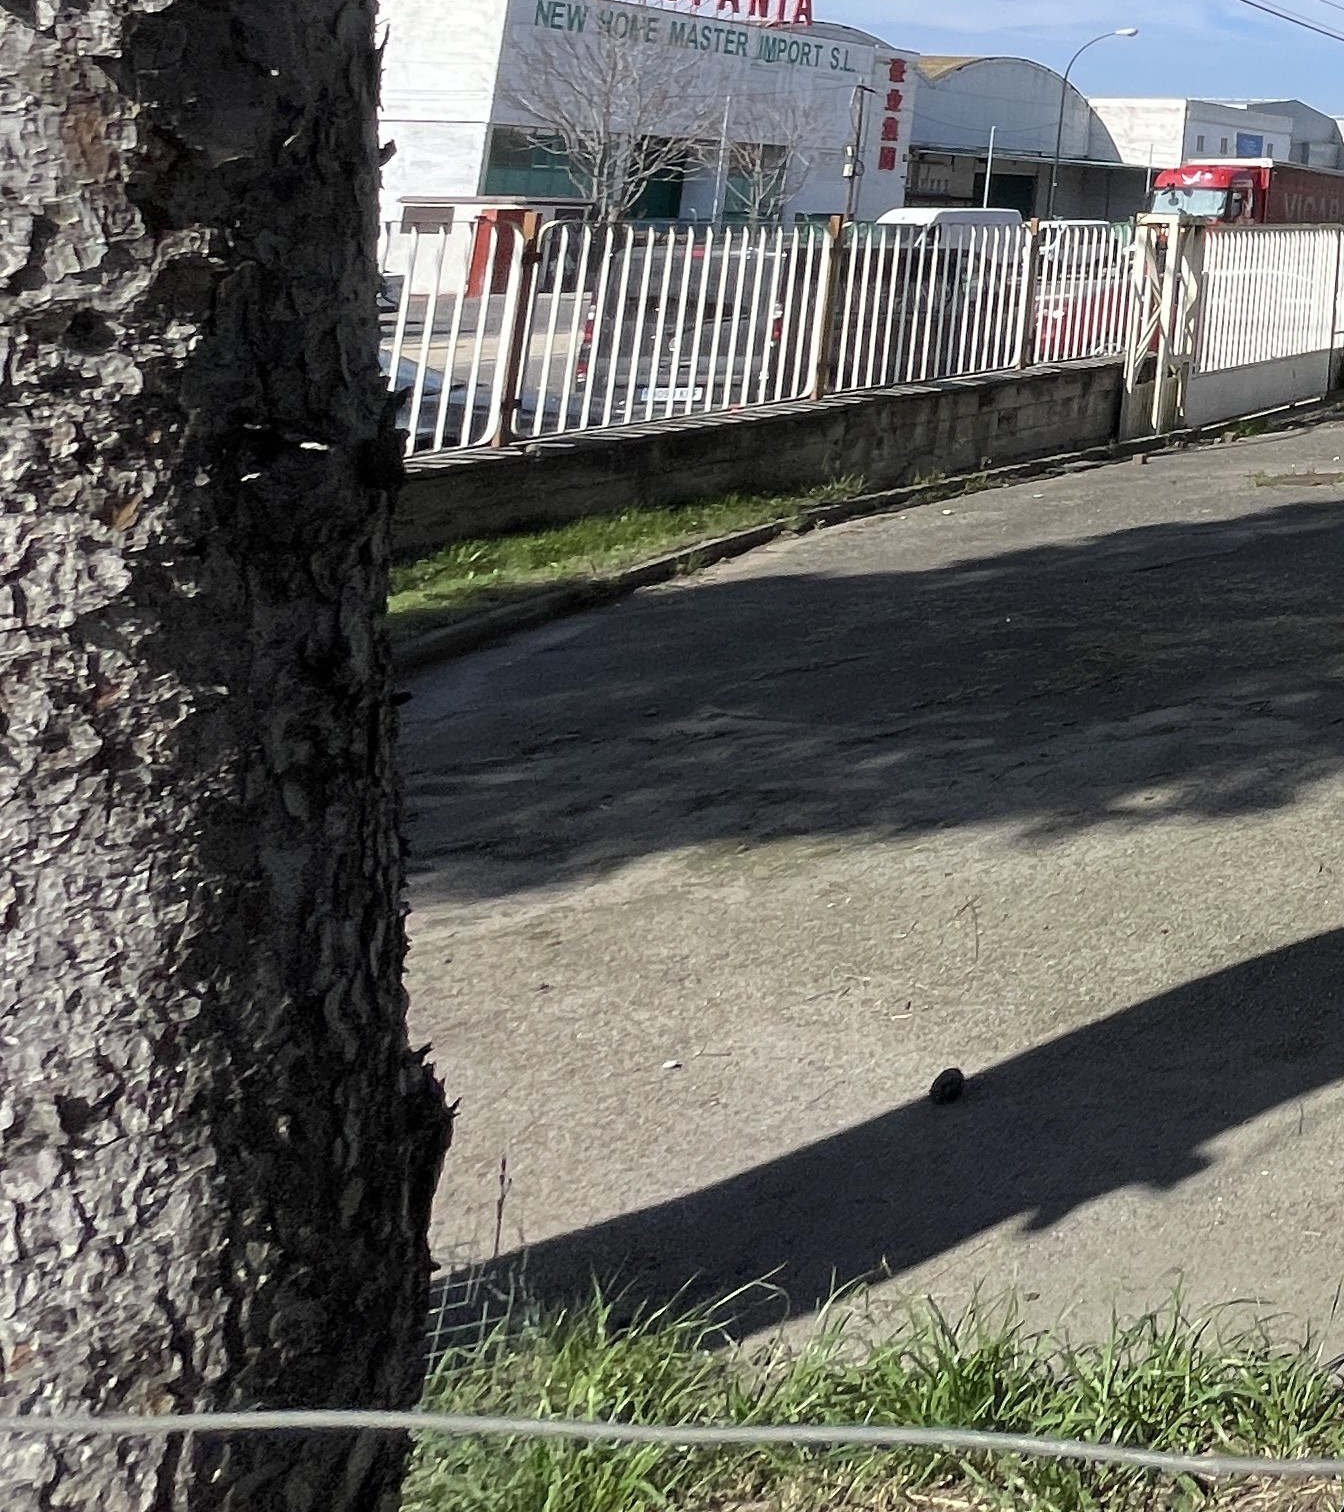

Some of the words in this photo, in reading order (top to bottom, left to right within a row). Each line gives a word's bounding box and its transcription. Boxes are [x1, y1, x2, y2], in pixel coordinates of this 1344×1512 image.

[669, 21, 748, 57] MASTER
[759, 35, 823, 68] IMPORT
[830, 47, 856, 73] S.L.
